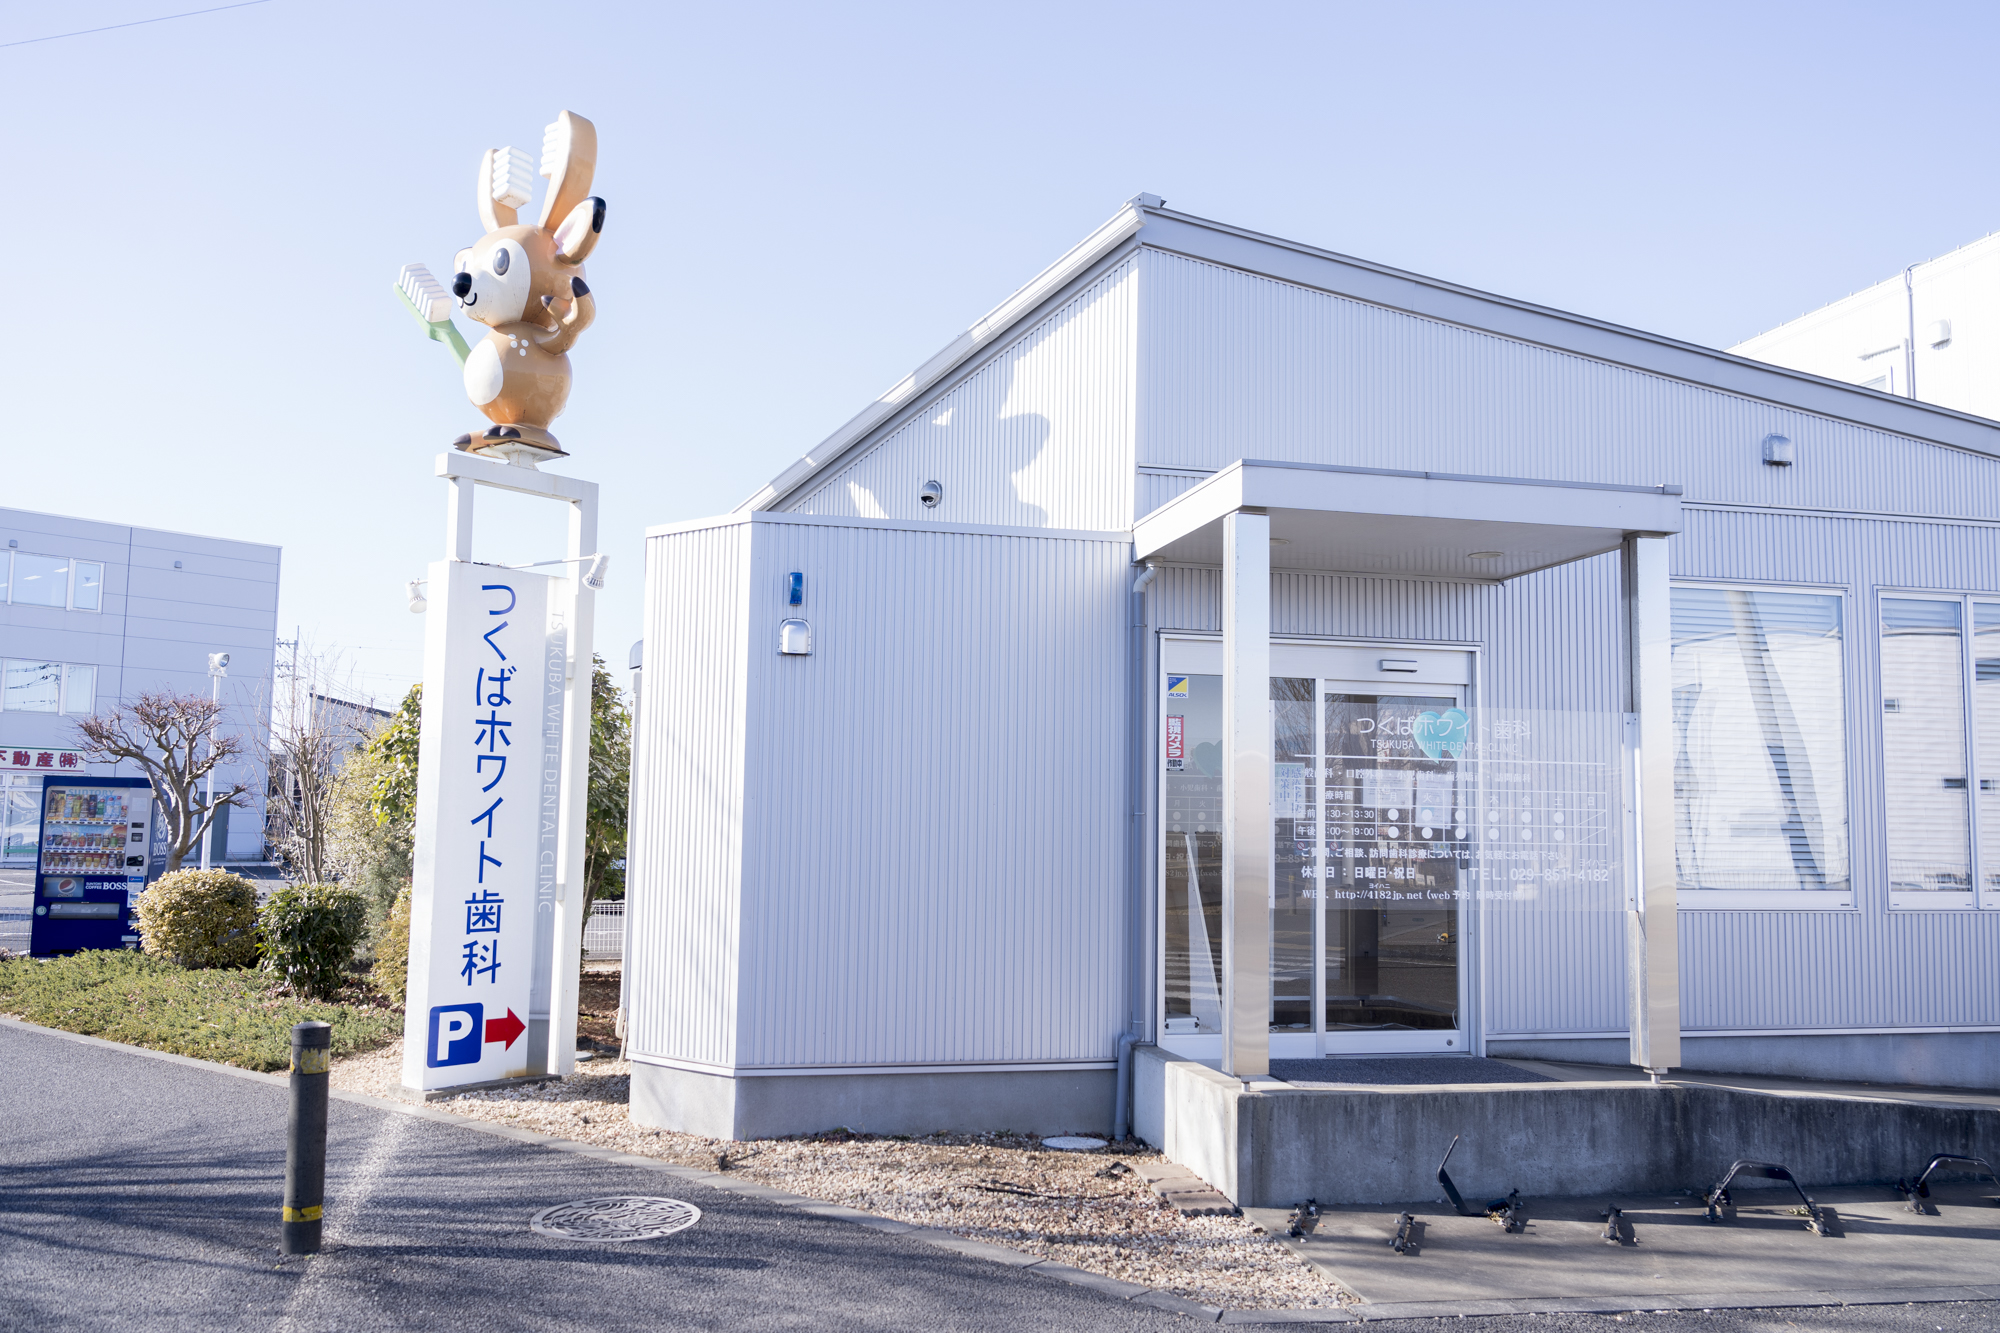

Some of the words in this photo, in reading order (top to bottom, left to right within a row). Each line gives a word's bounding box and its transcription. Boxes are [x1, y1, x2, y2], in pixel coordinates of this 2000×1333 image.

[547, 610, 565, 696] TSUKUBA
[544, 703, 561, 763] WHITE
[1168, 717, 1182, 757] 監視カメラ
[1370, 739, 1415, 750] TSUKUBA
[1417, 740, 1447, 751] WHITE
[1488, 742, 1519, 753] CLINIC
[461, 583, 517, 986] つくばホワイト歯科
[1318, 790, 1354, 801] 療時間
[1389, 792, 1397, 802] 月
[1423, 793, 1432, 803] 火
[1457, 794, 1466, 804] 水
[1489, 795, 1499, 805] 木
[1522, 795, 1531, 806] 金
[1554, 796, 1563, 806] 土
[541, 767, 559, 844] DENTAL
[1587, 797, 1595, 806] 日
[1297, 825, 1316, 836] 午後
[153, 842, 167, 856] BOSS
[103, 881, 127, 890] BOSS
[538, 850, 555, 914] CLINIC
[1302, 889, 1329, 899] WE.
[437, 1010, 474, 1061] P
